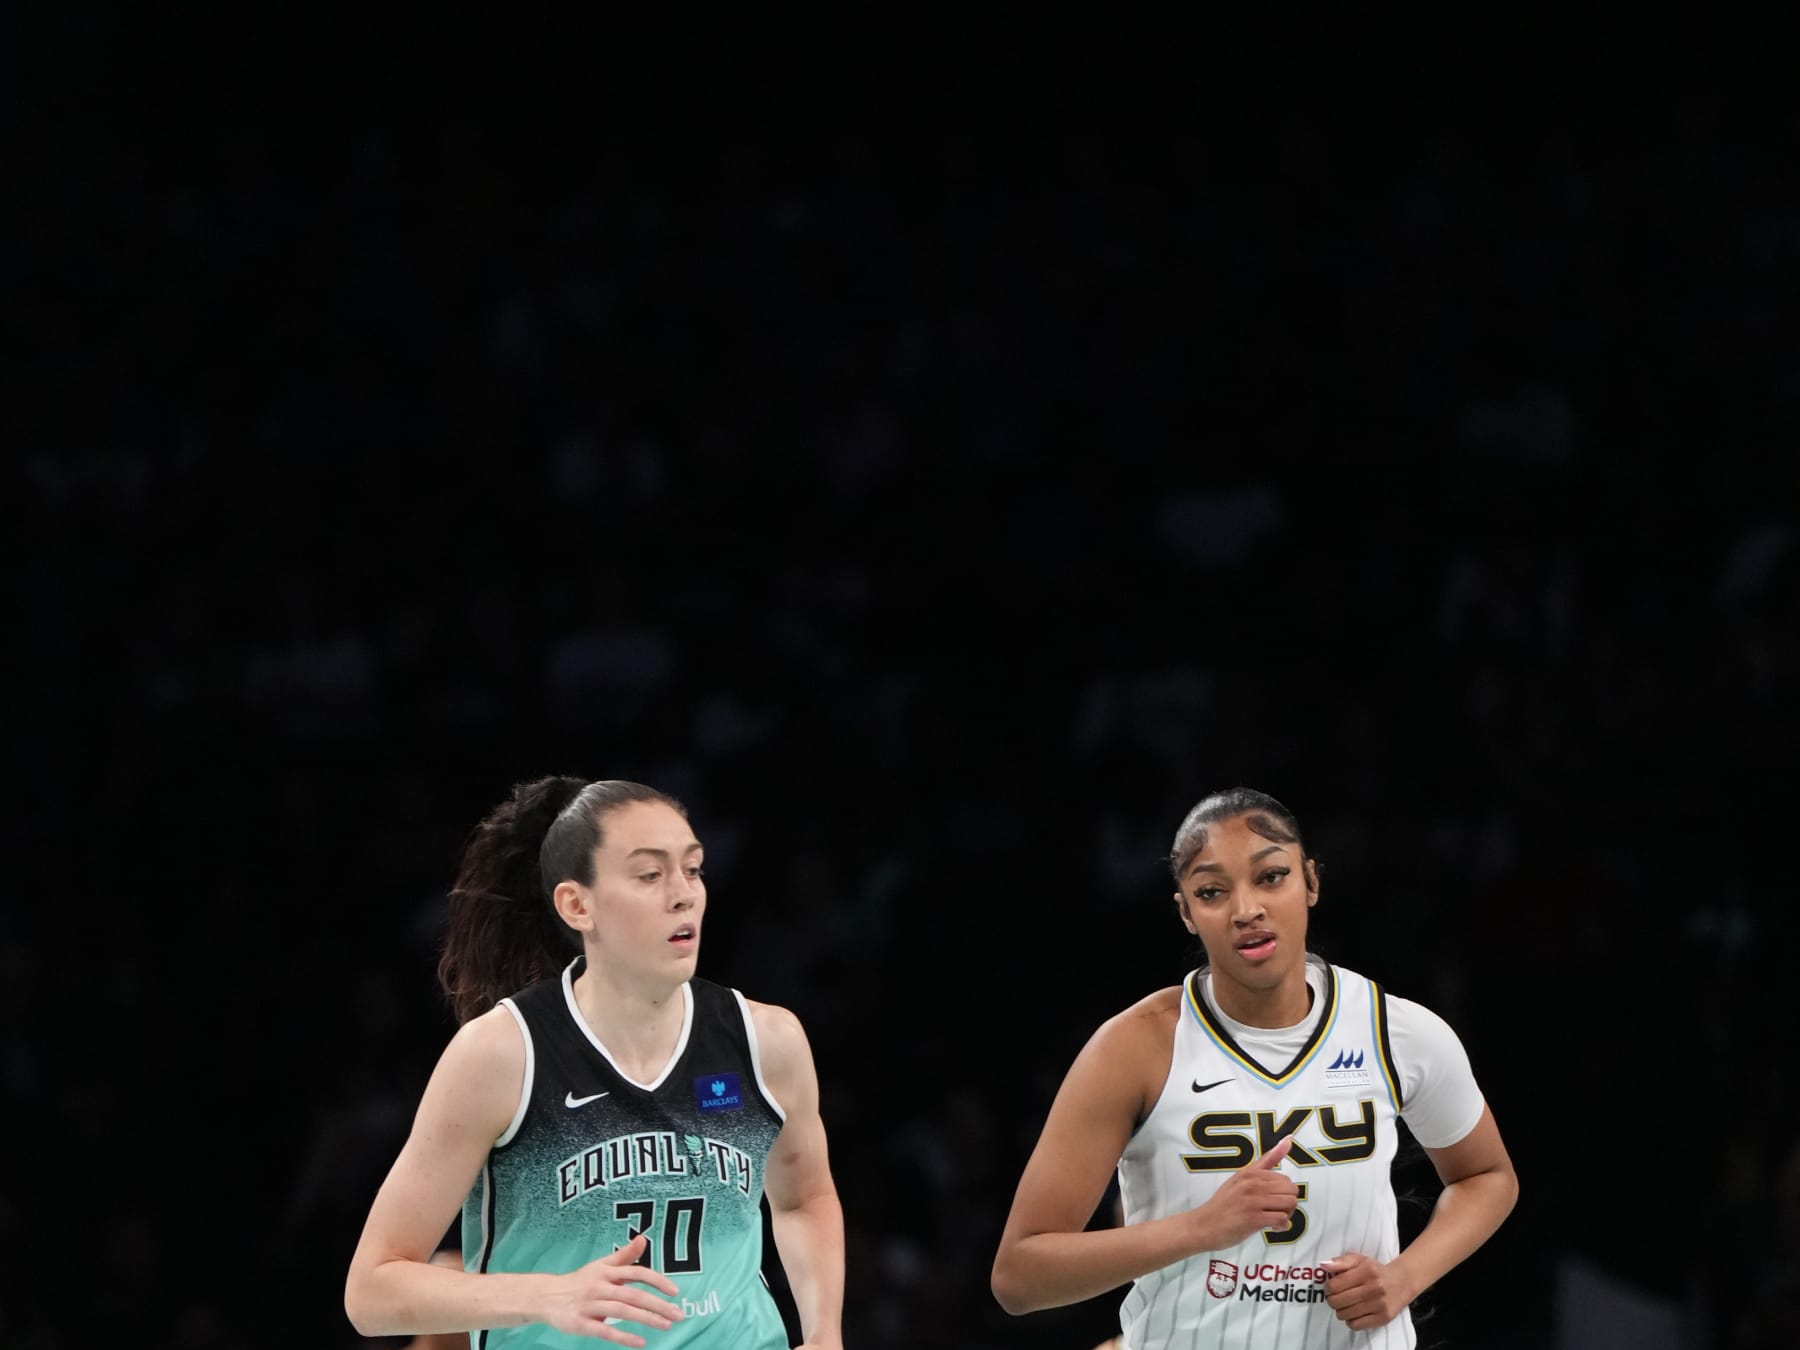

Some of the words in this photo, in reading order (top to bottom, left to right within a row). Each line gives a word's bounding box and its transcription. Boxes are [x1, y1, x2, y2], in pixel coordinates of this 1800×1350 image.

[702, 1096, 738, 1107] BARCLAYS
[1180, 1099, 1377, 1172] SKY
[613, 1197, 706, 1276] 30
[1244, 1263, 1330, 1284] UChicag
[1240, 1283, 1328, 1303] Medicin
